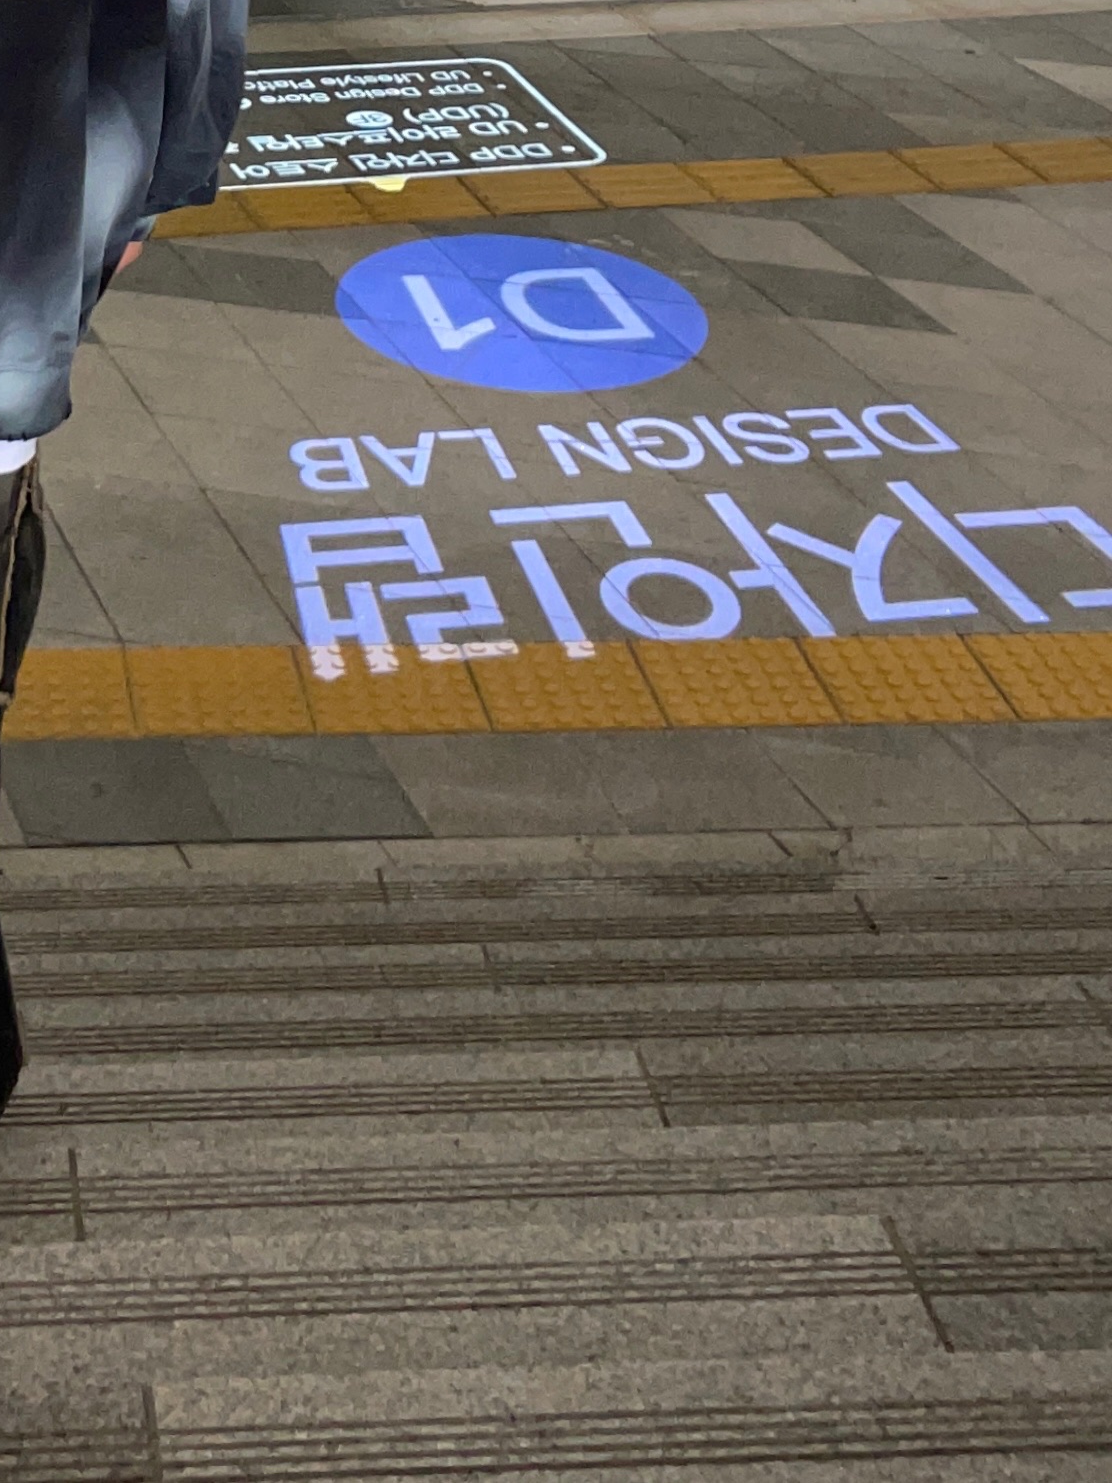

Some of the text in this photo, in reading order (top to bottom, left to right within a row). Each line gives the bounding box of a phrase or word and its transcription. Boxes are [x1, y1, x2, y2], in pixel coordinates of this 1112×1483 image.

[244, 69, 471, 91] UD Lifestyle Platfo
[428, 82, 484, 96] DDP
[259, 92, 331, 105] Store
[334, 86, 422, 100] Design
[402, 102, 509, 124] (UDP)
[246, 125, 462, 152] 라이프스타일
[468, 120, 528, 136] UD
[229, 142, 553, 180] DDP 디자인 스토어
[400, 266, 656, 351] D1
[290, 403, 962, 492] DESIGN LAB
[281, 480, 1112, 681] 디자인랩
